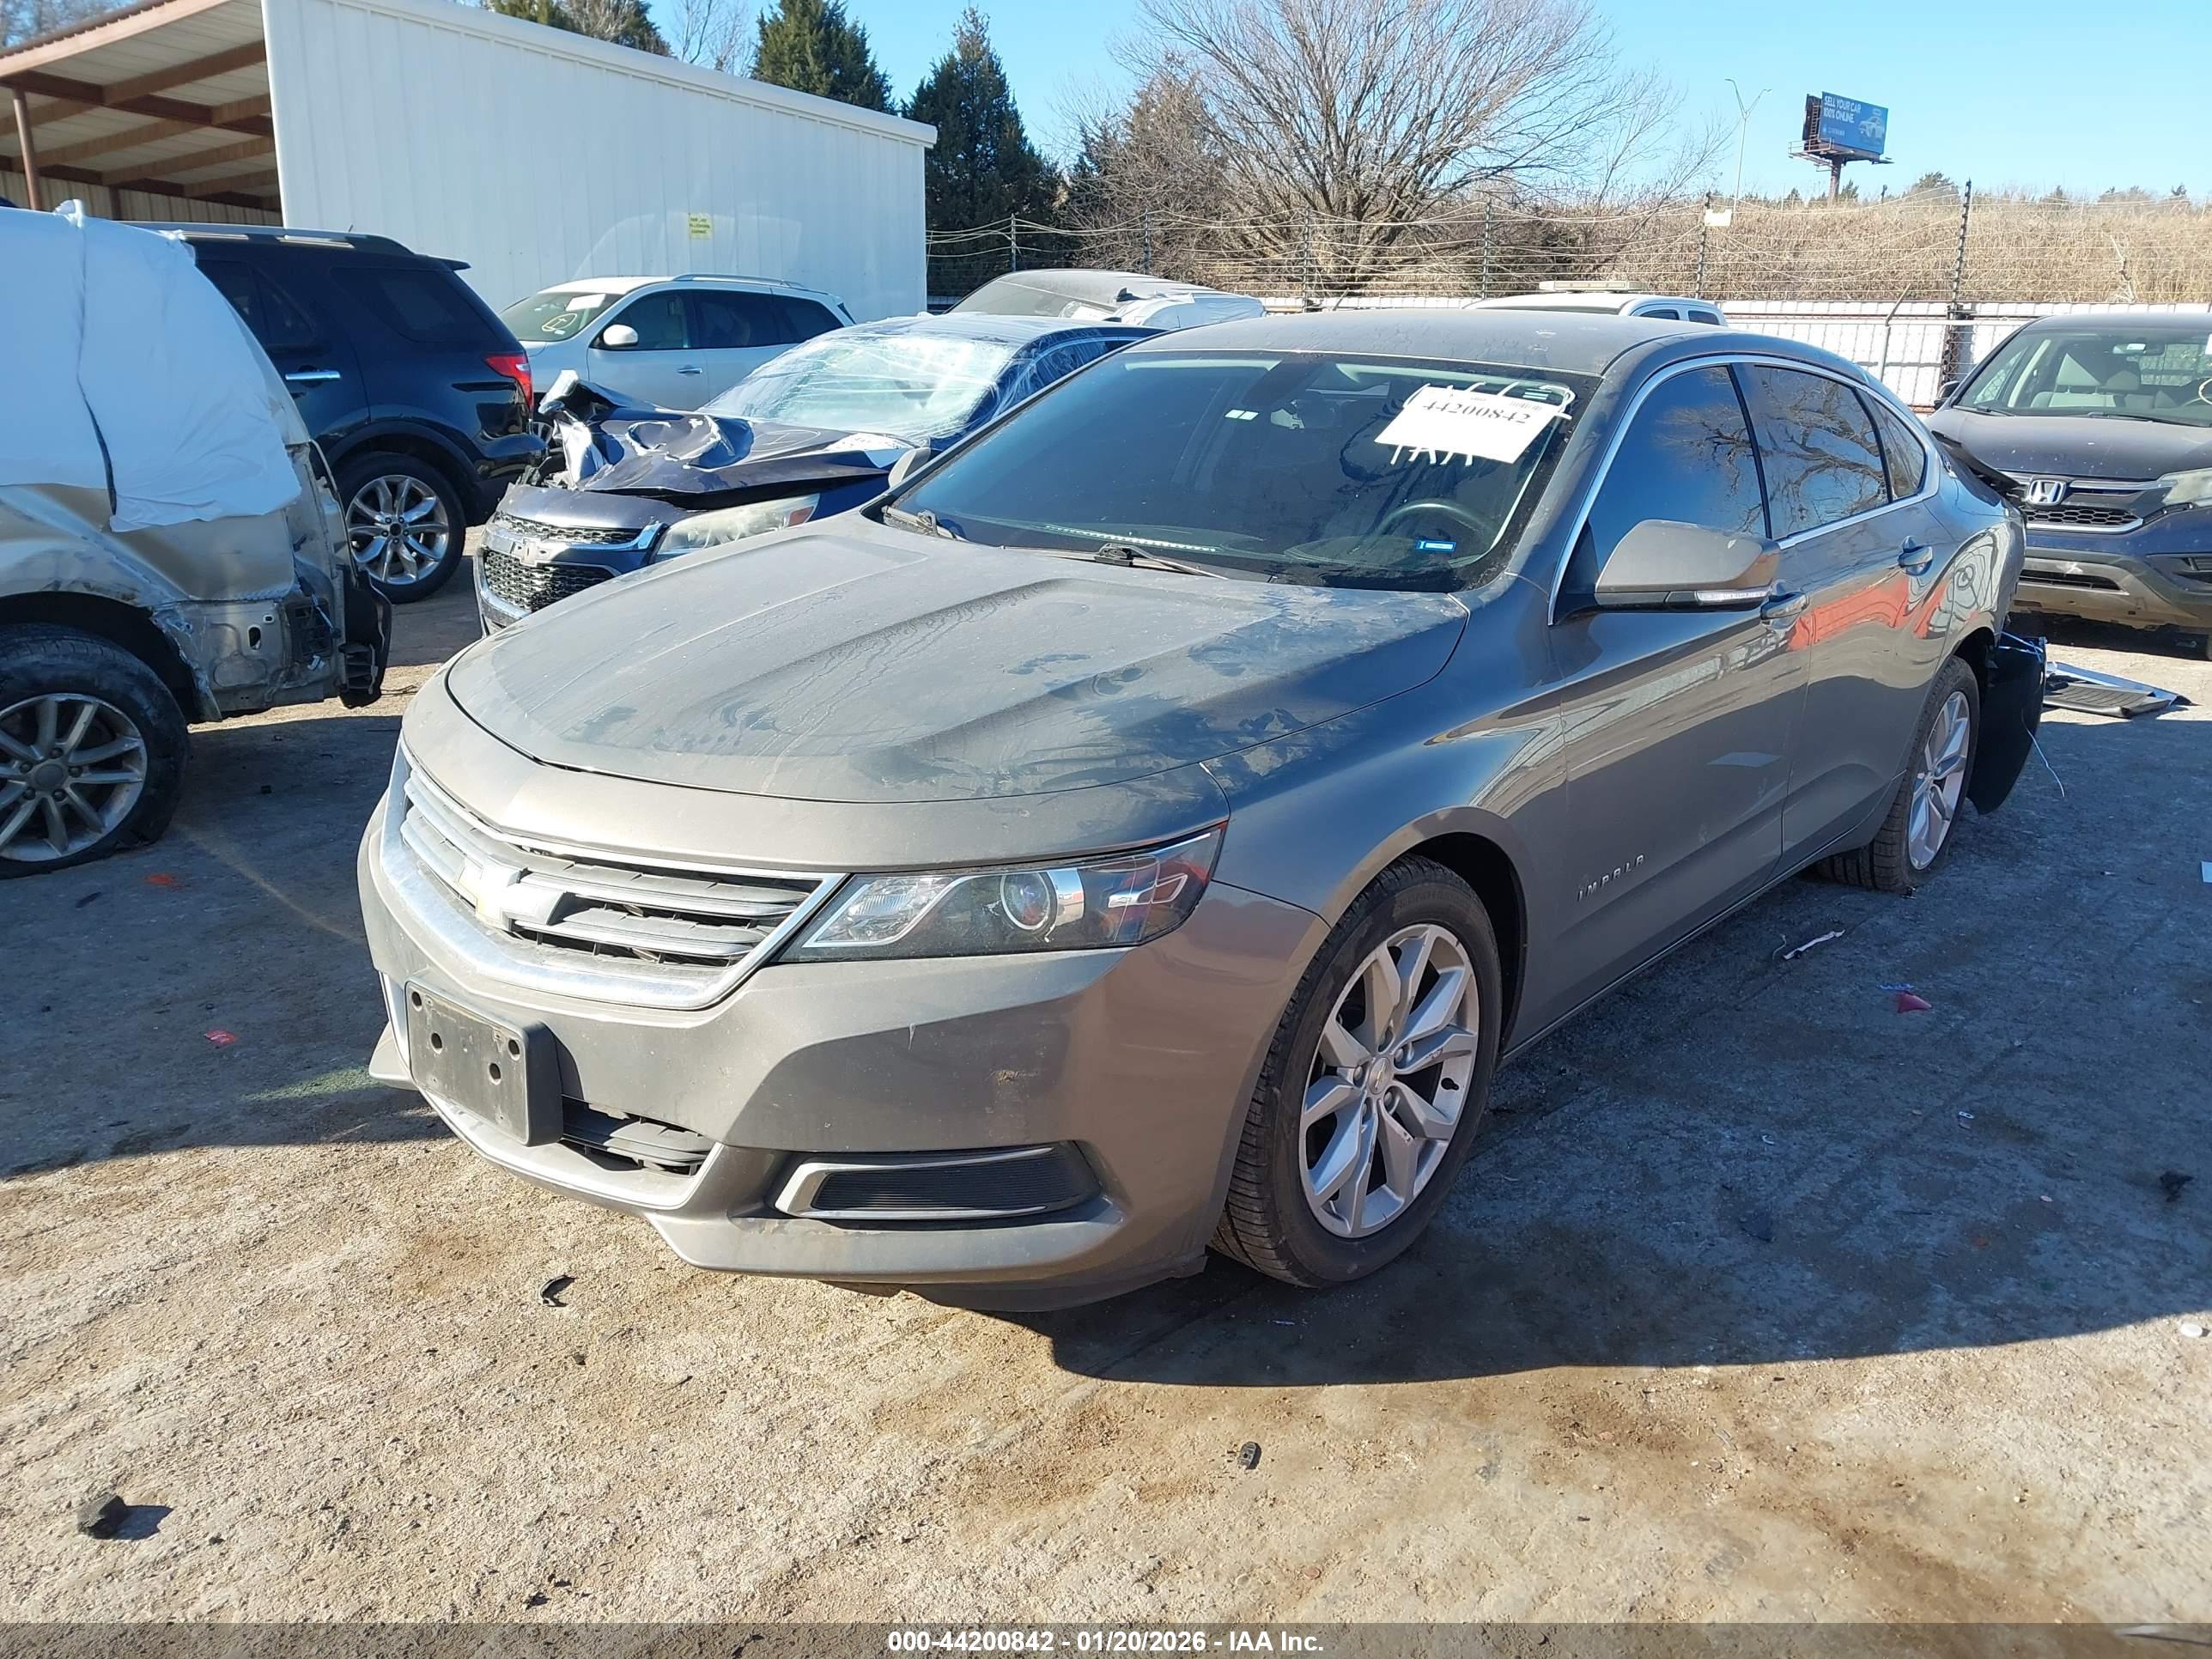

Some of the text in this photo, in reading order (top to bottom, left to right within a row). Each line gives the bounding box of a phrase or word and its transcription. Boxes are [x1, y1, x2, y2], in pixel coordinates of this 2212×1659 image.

[1824, 95, 1836, 107] SELL
[1837, 99, 1850, 112] YOUR
[1850, 102, 1862, 113] CAR
[1422, 400, 1531, 424] 44200842
[1578, 854, 1644, 901] IMPALA
